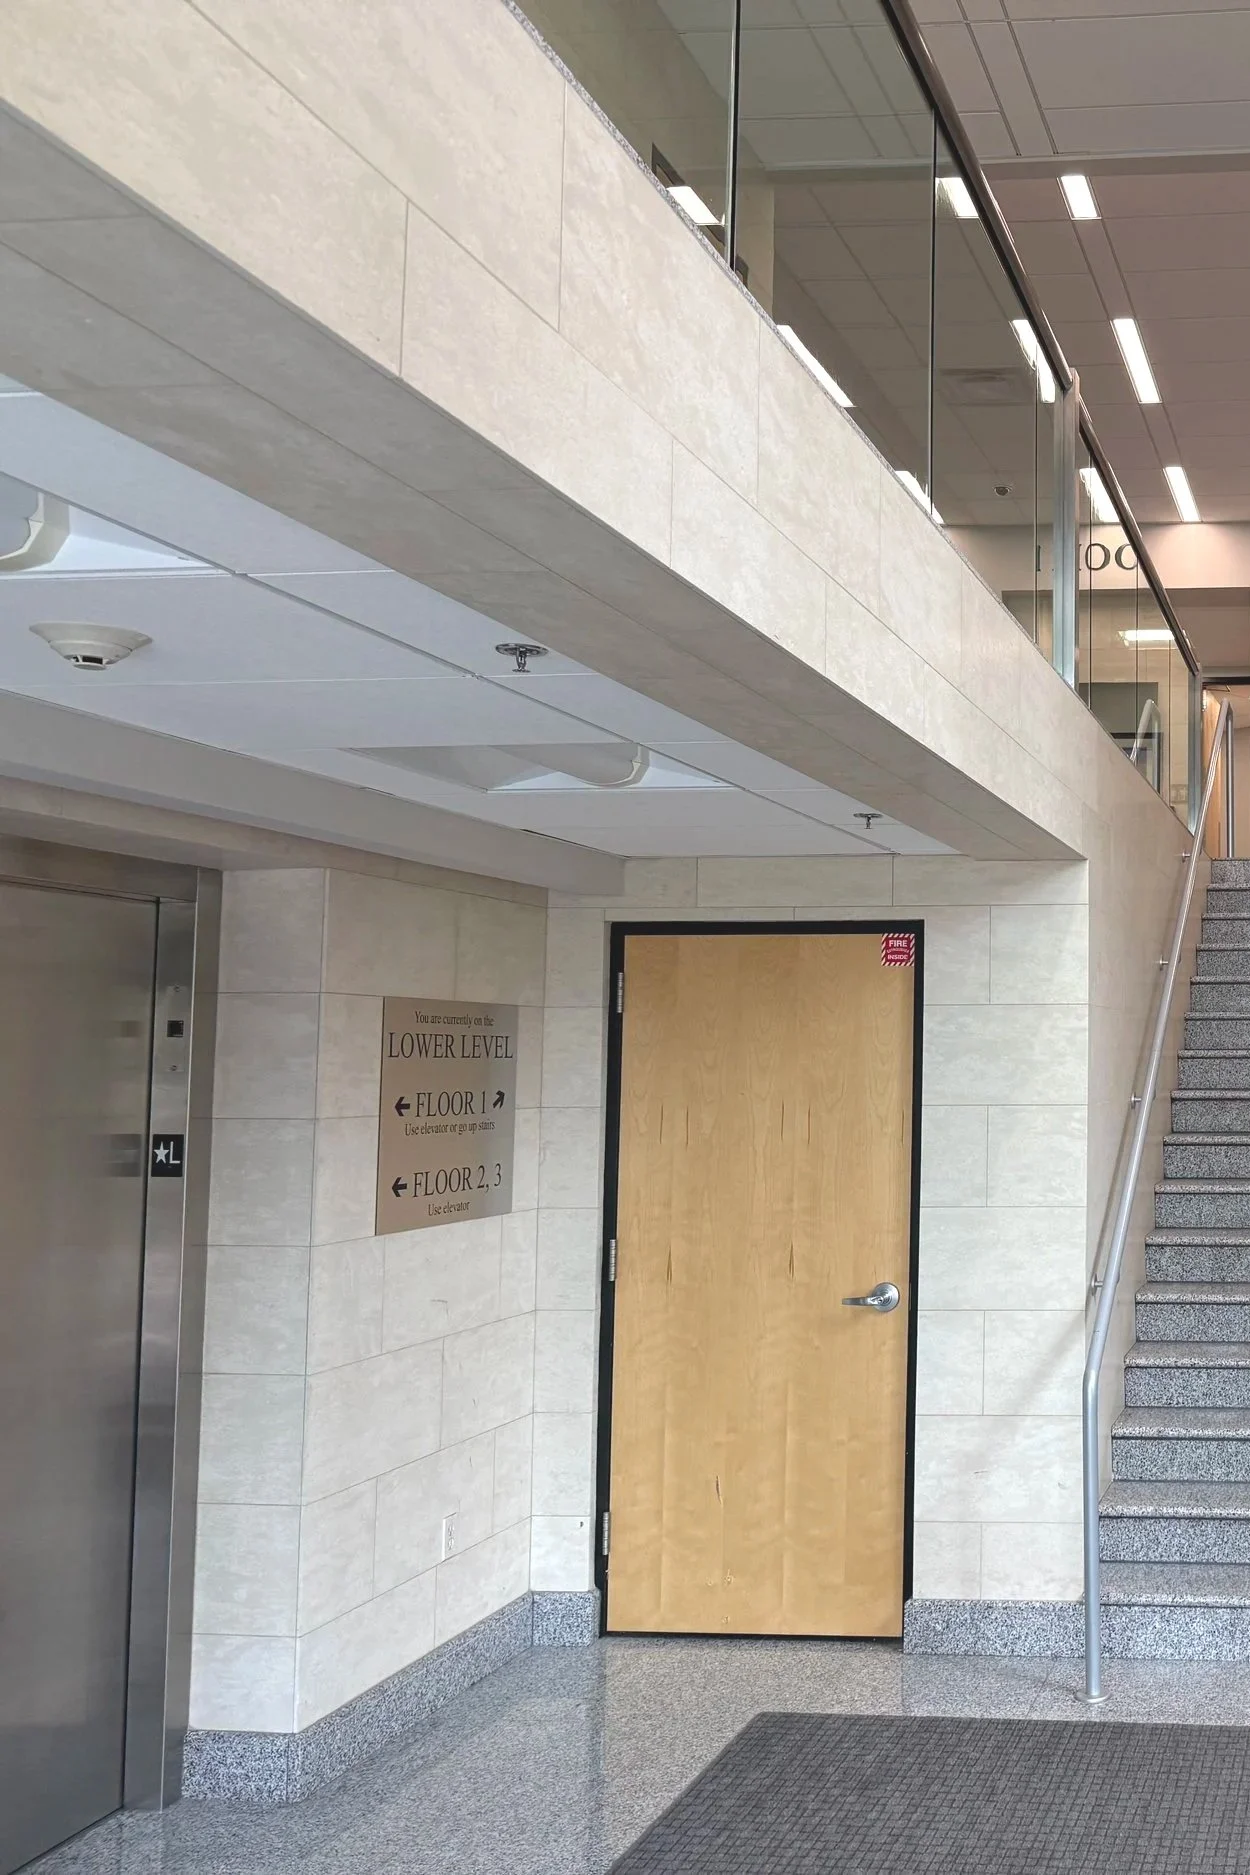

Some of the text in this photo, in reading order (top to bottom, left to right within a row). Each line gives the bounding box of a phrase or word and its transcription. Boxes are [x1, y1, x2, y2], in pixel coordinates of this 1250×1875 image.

[888, 939, 908, 948] FIRE
[415, 1010, 495, 1029] You are currently on the
[388, 1031, 514, 1059] LOWER LEVEL
[415, 1090, 486, 1118] FLOOR 1
[405, 1118, 496, 1136] Use elevator or go up stairs
[169, 1141, 181, 1164] L
[412, 1163, 502, 1198] FLOOR 2, 3
[428, 1201, 470, 1216] Use elevator
